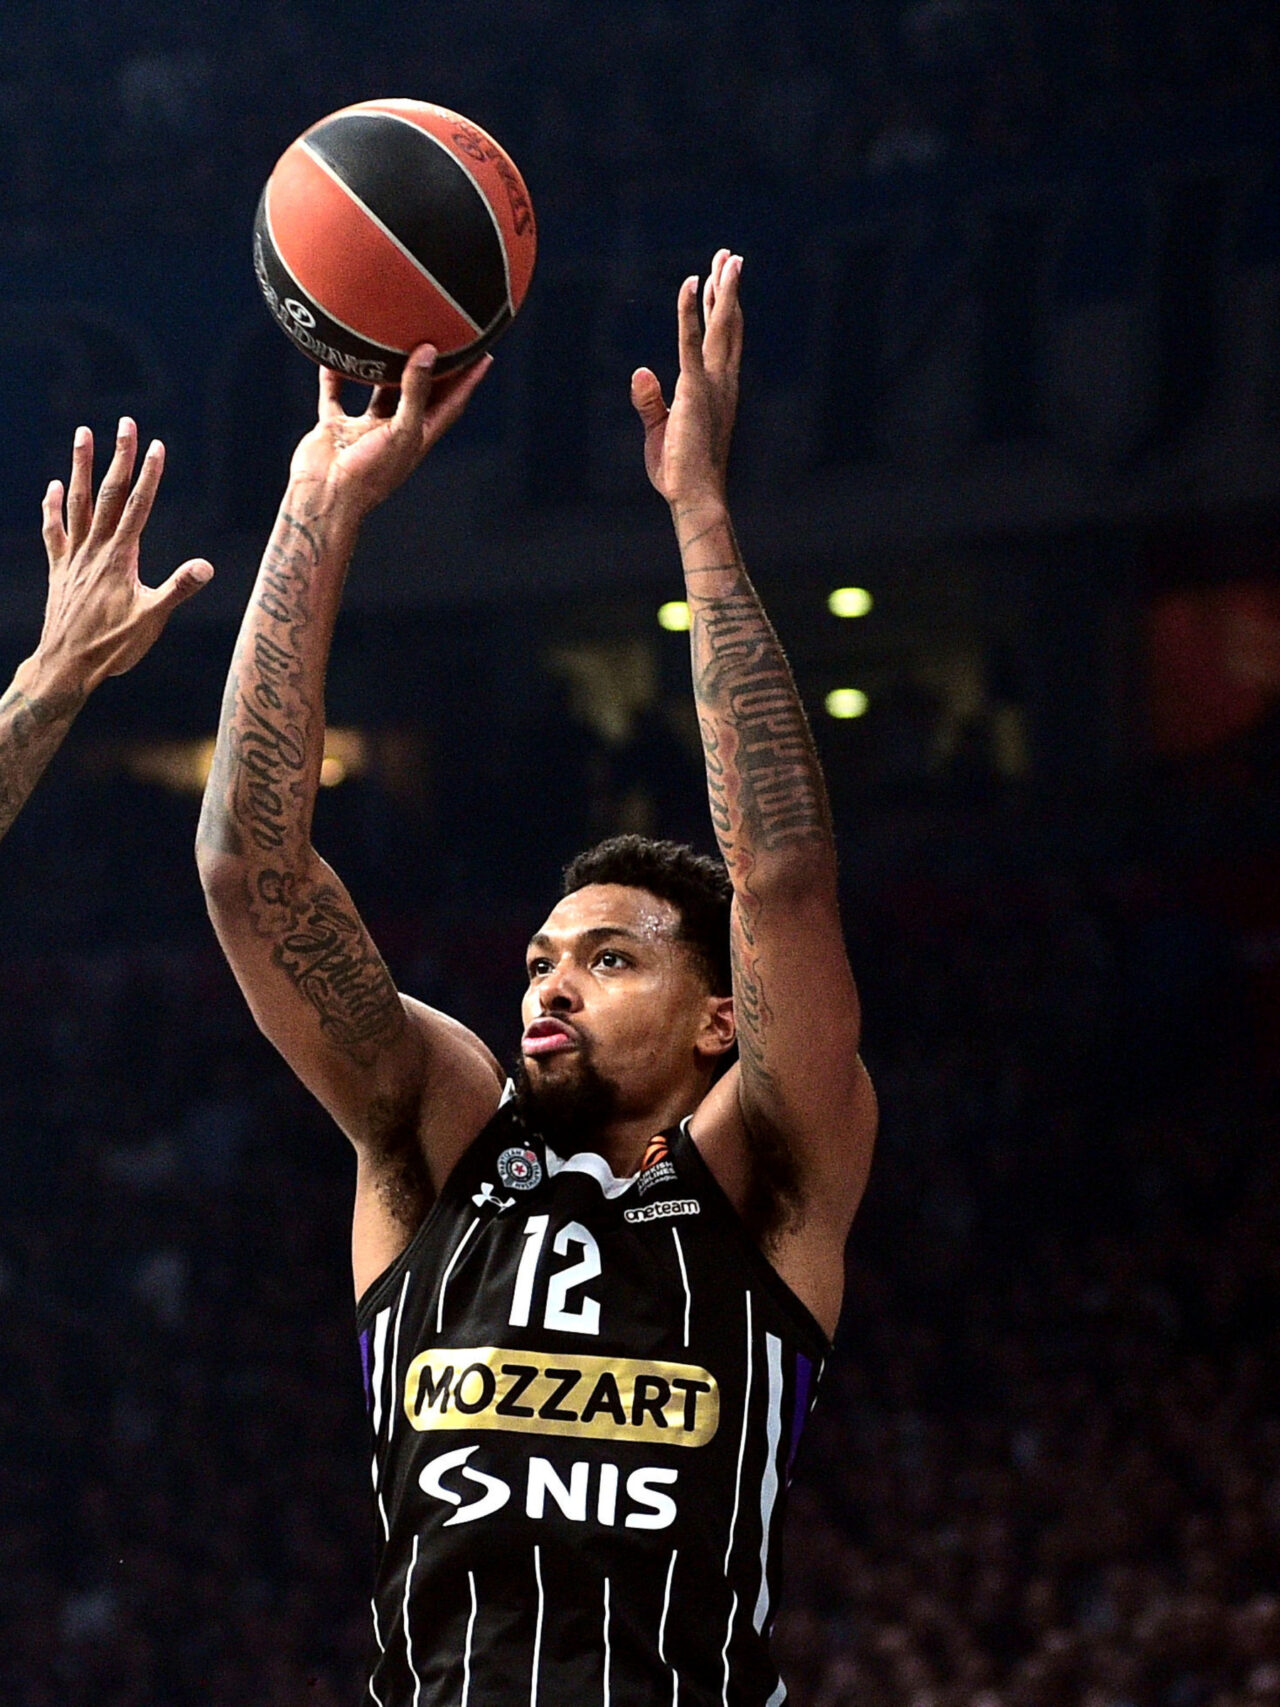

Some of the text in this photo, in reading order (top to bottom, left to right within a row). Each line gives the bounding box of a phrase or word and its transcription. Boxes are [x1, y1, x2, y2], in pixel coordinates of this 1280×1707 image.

[624, 1200, 699, 1222] oneteam
[508, 1214, 602, 1336] 12
[413, 1362, 711, 1433] MOZZART
[525, 1456, 679, 1531] NIS
